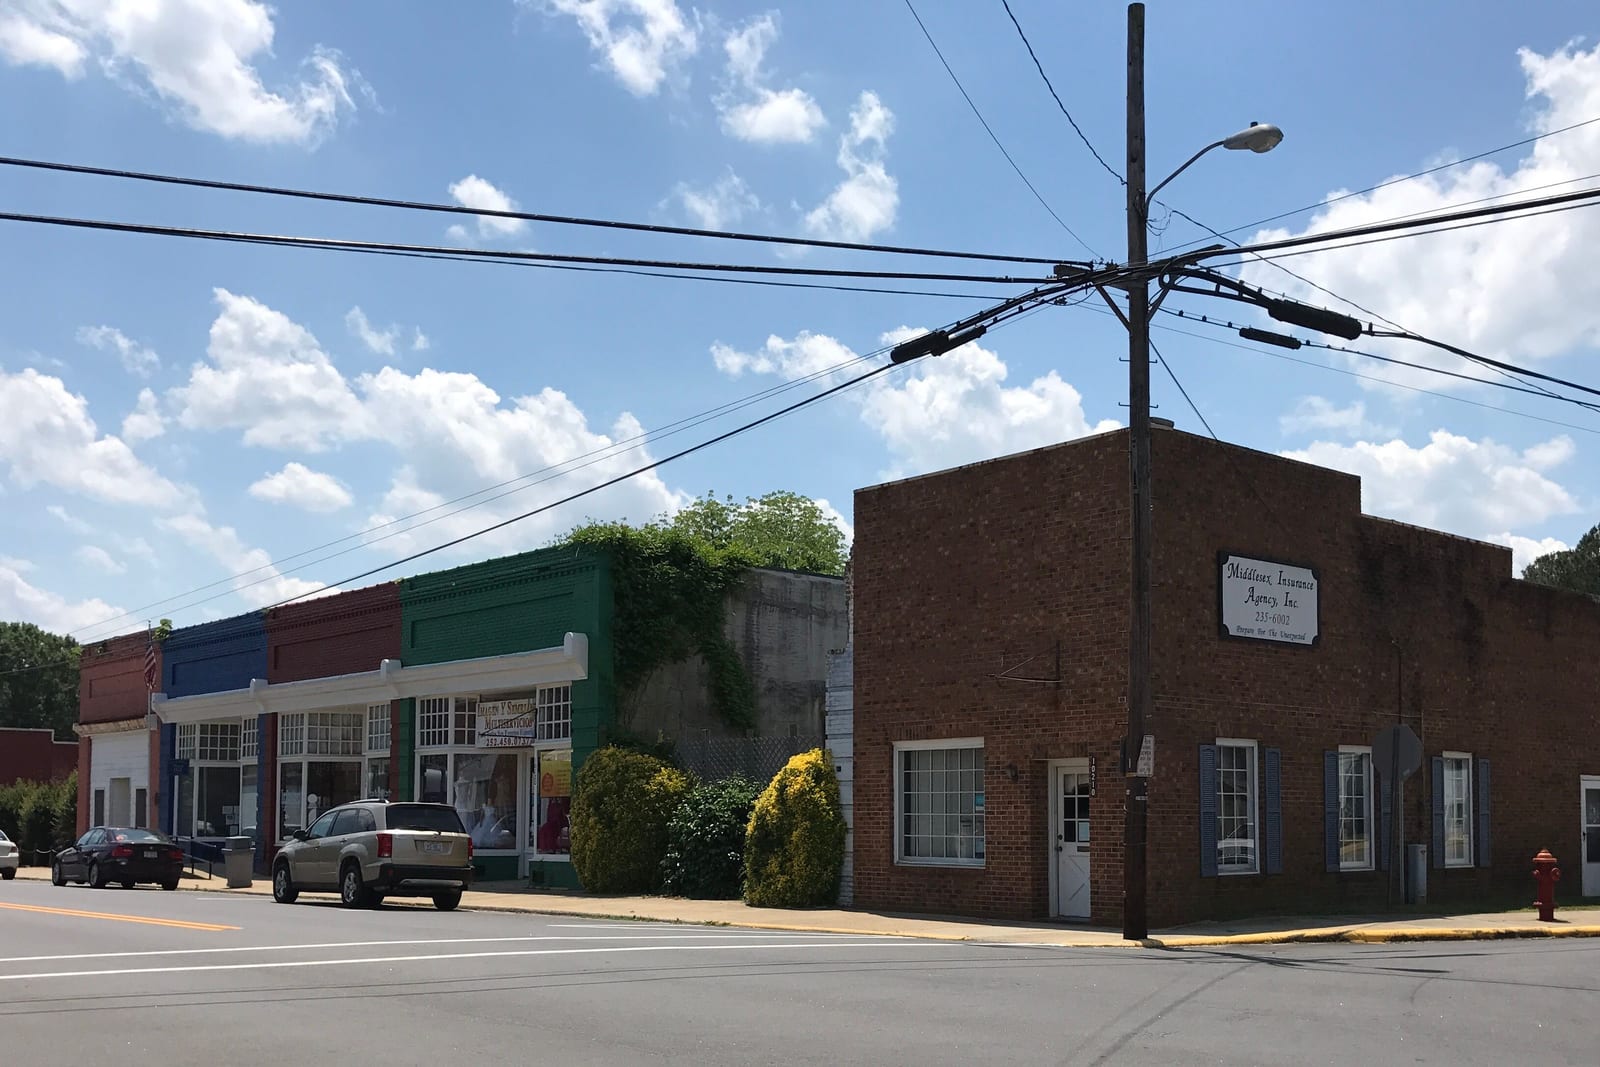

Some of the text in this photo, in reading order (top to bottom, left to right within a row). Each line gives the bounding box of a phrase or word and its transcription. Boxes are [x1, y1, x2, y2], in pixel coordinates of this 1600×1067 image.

[1227, 562, 1314, 590] Middlesex Insurance
[1244, 586, 1299, 609] Agency, Inc.
[1255, 611, 1290, 626] 235-6002
